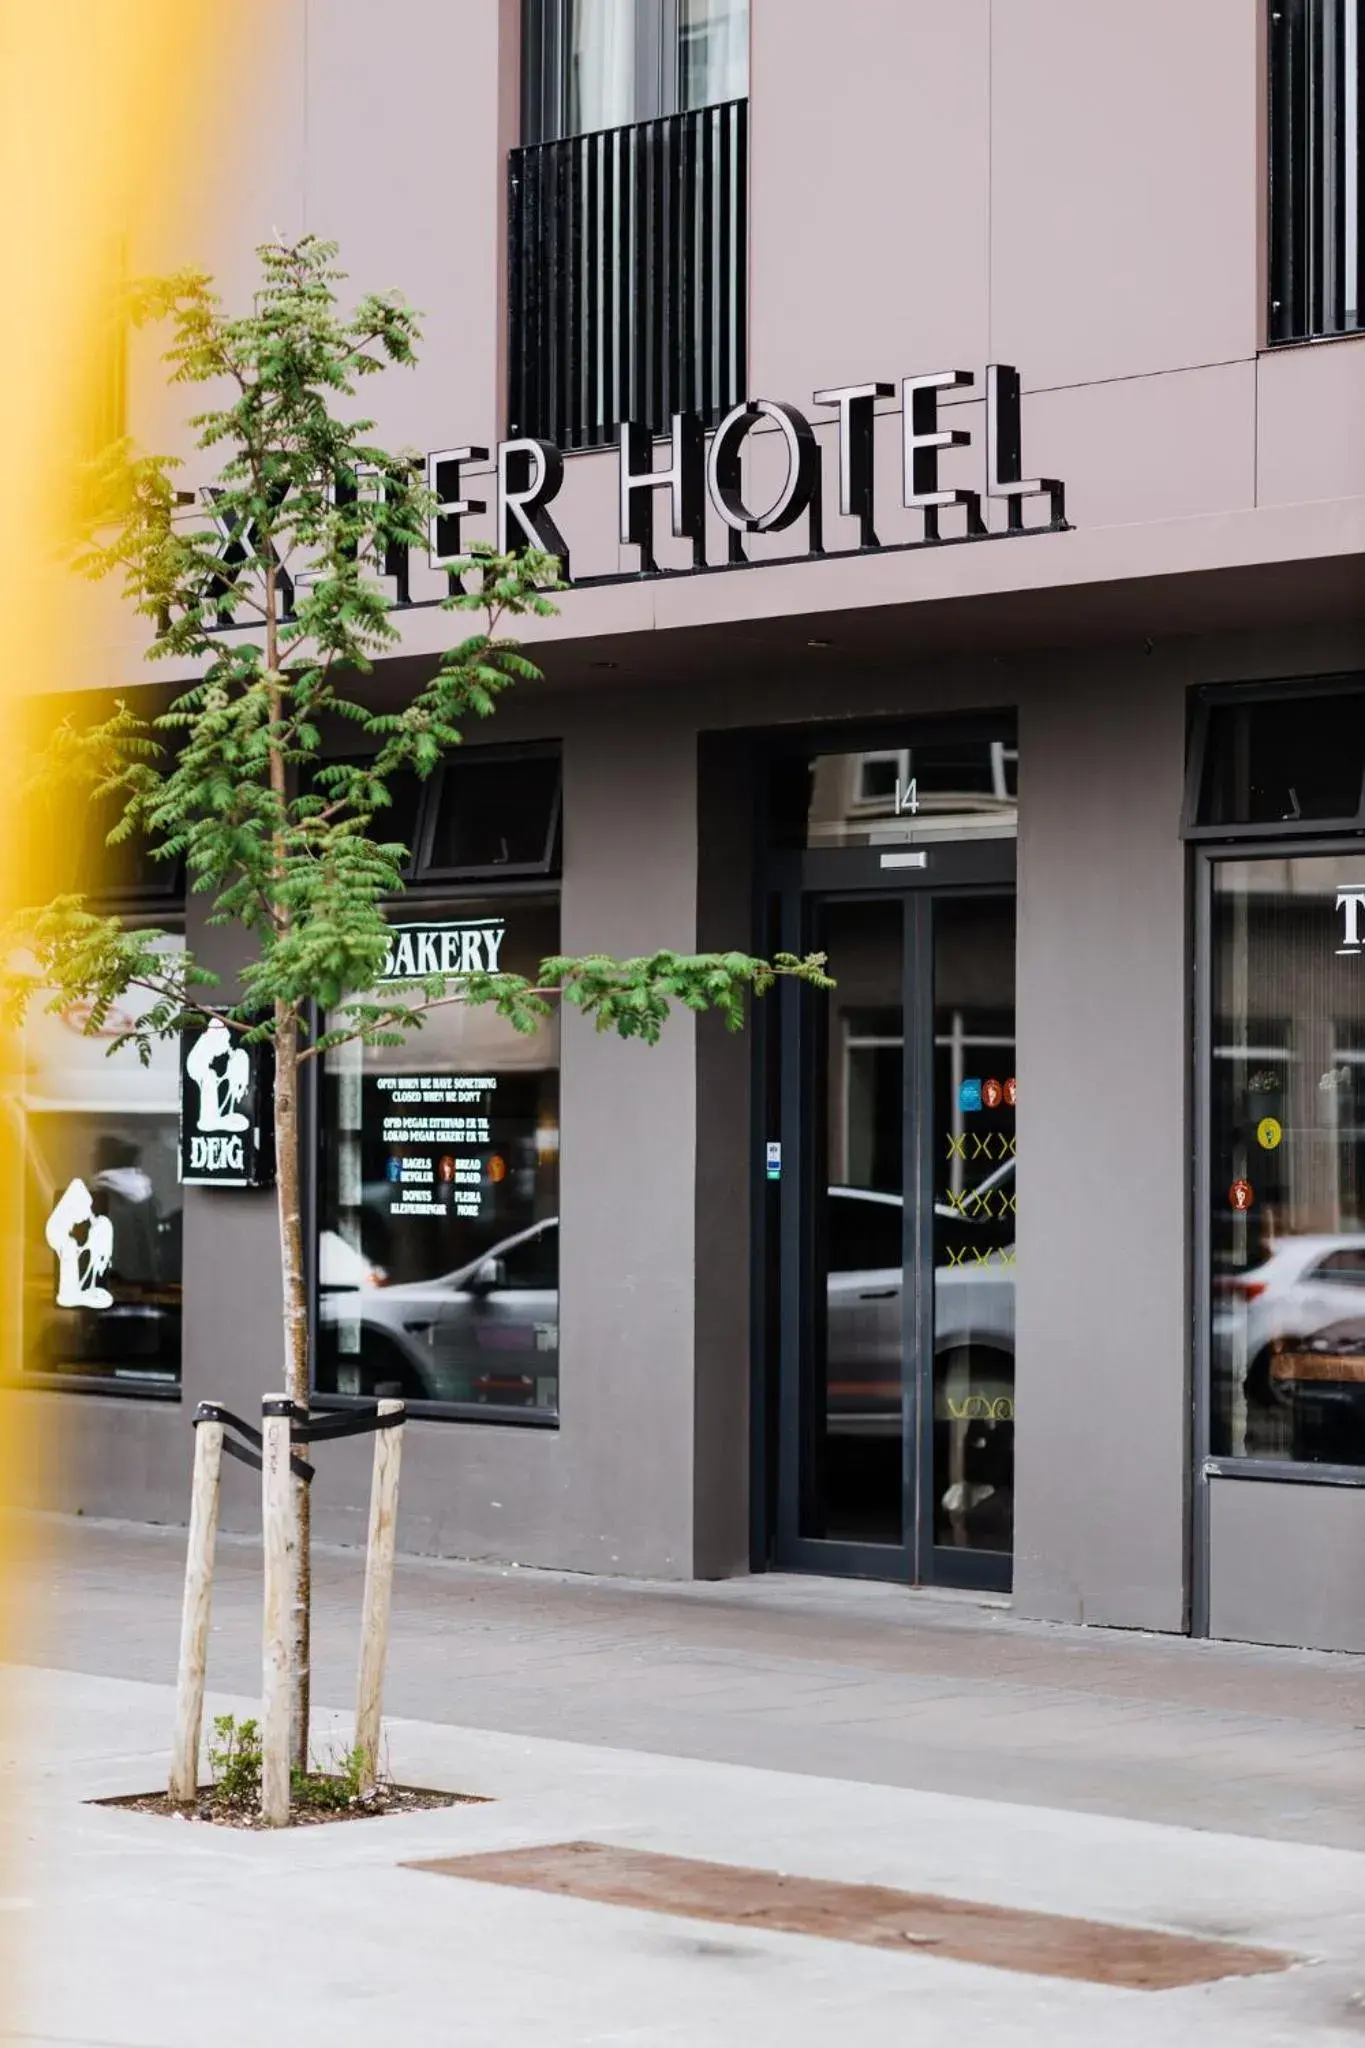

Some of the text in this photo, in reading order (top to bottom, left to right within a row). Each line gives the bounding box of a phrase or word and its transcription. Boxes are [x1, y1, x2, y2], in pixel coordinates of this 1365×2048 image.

[619, 364, 1062, 546] HOTEL
[894, 777, 920, 815] 14
[392, 1090, 422, 1103] CLOSED
[190, 1134, 244, 1172] DEIG
